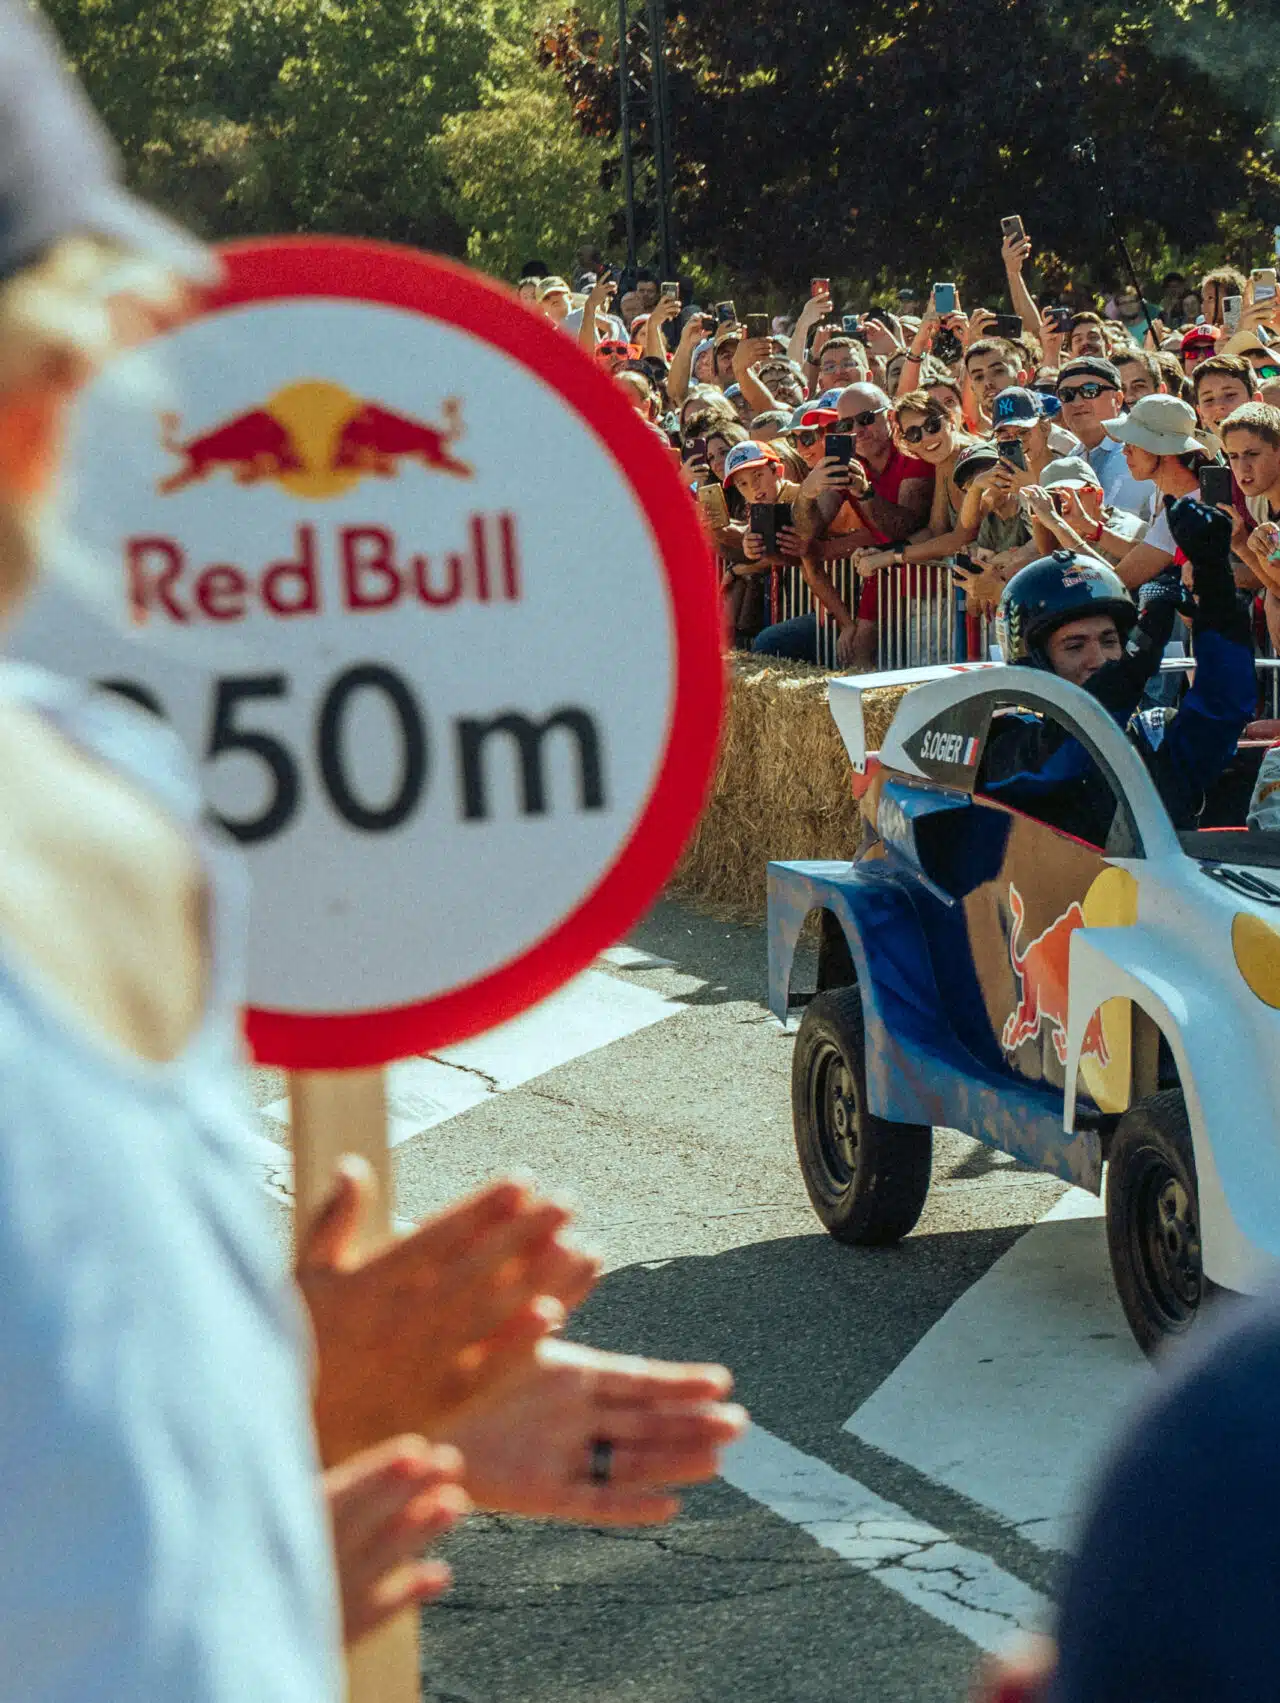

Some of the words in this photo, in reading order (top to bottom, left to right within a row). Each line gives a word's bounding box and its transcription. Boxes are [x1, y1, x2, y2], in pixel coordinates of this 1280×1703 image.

[124, 524, 320, 626] Red
[340, 510, 522, 613] Bull
[95, 658, 609, 846] 50m
[920, 730, 963, 765] S.OGIER
